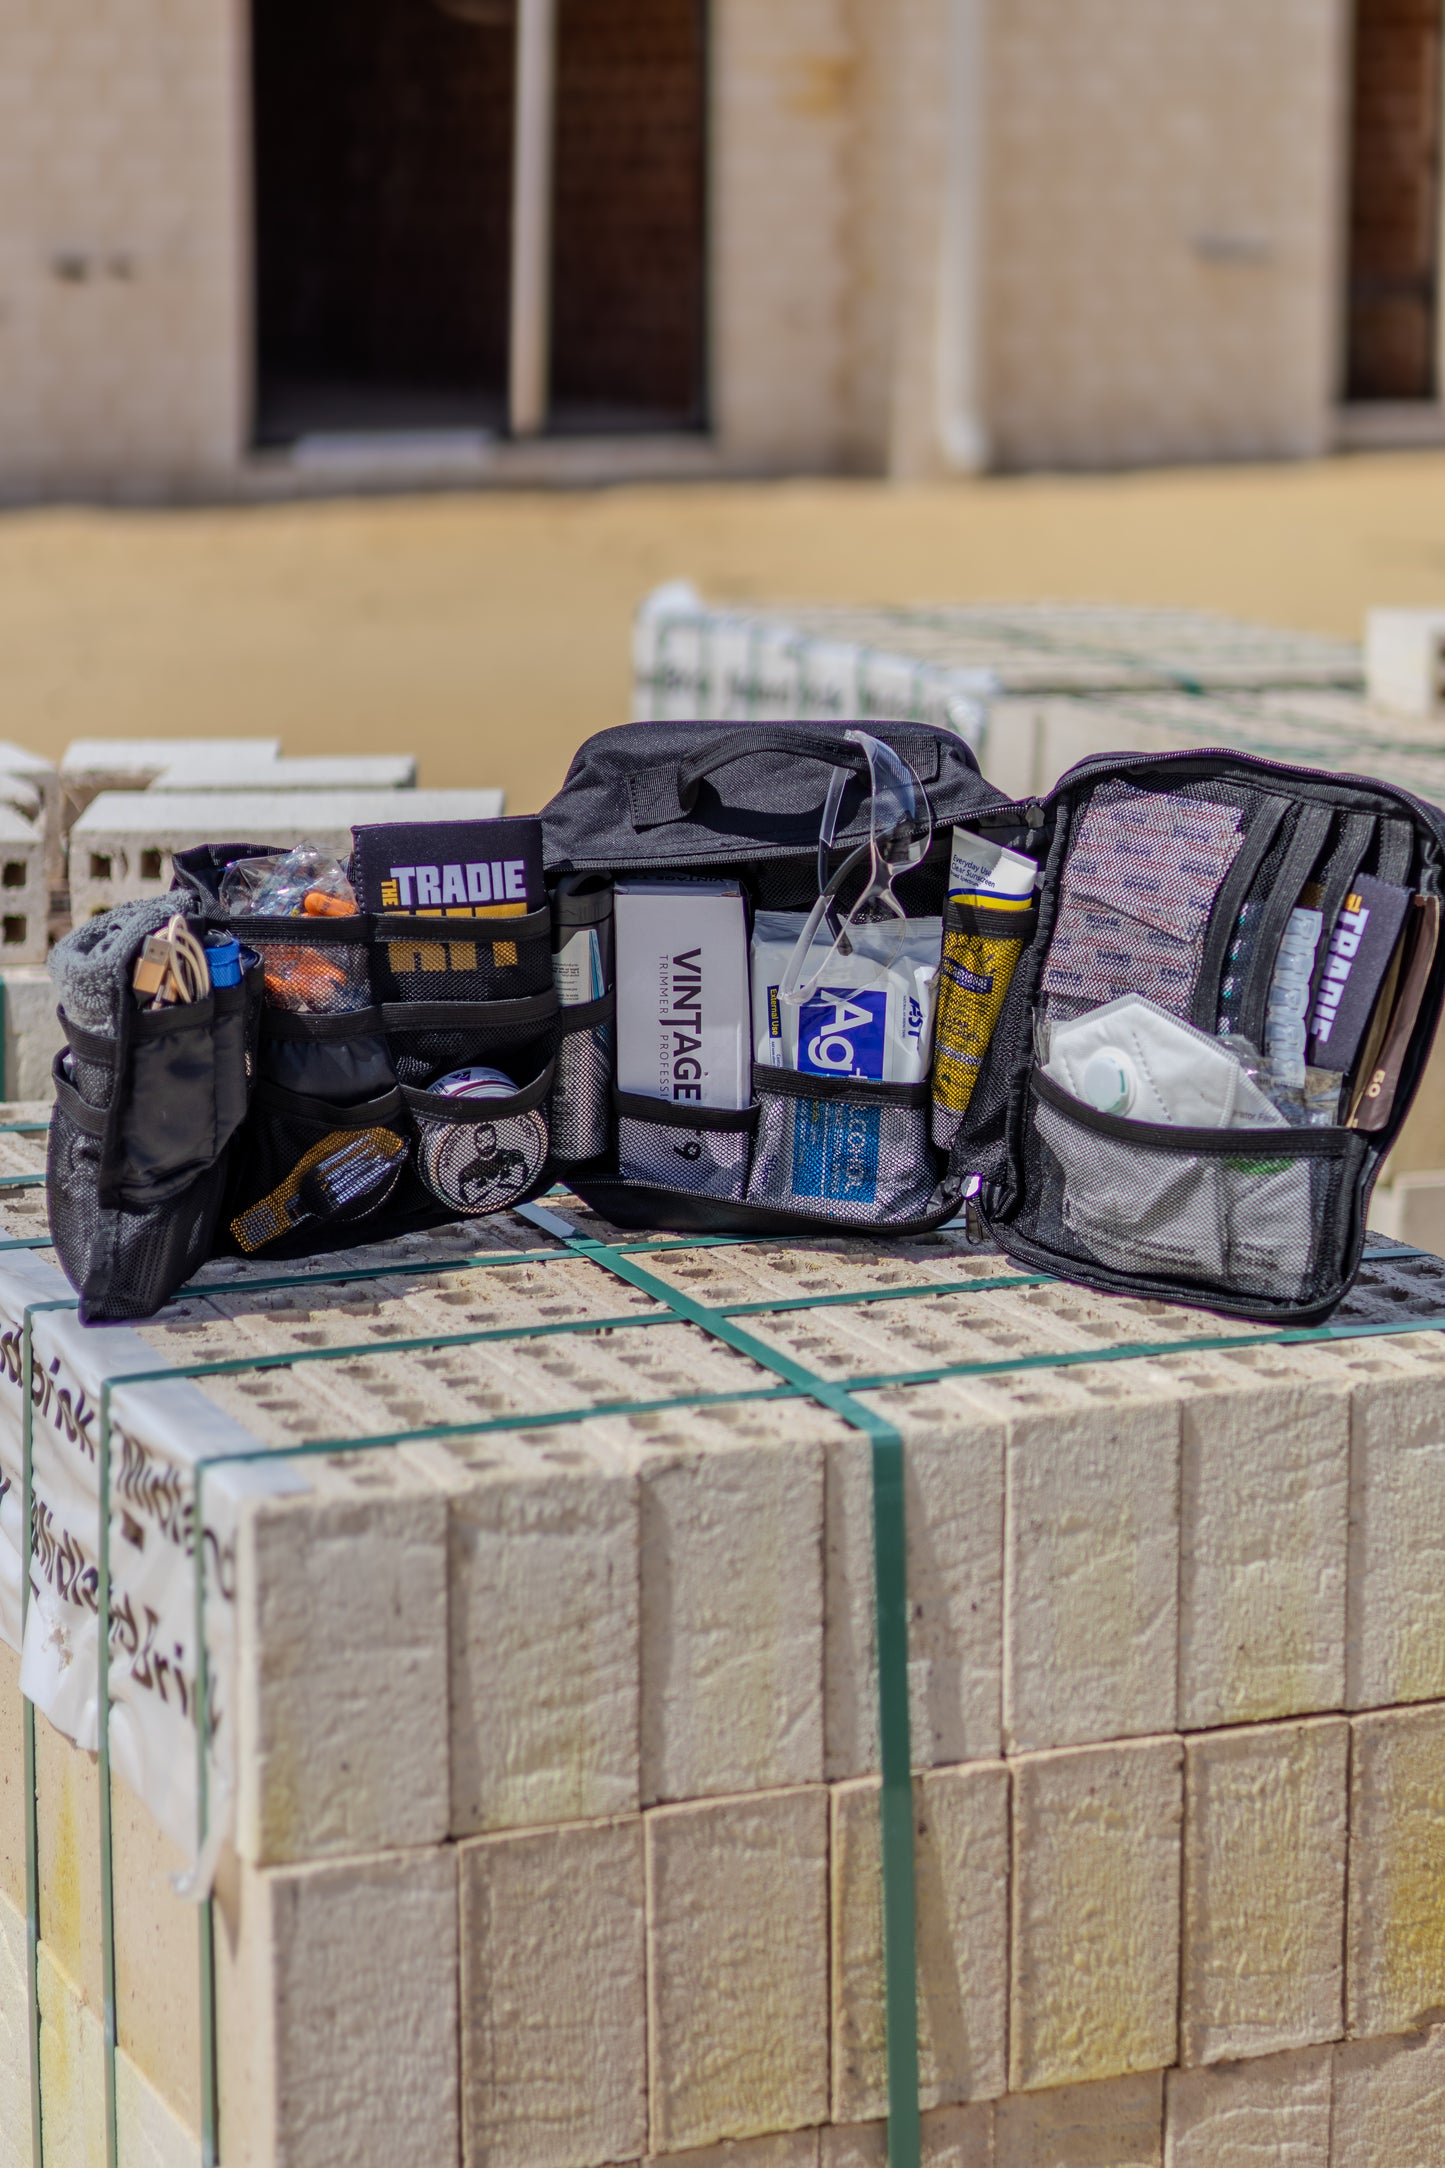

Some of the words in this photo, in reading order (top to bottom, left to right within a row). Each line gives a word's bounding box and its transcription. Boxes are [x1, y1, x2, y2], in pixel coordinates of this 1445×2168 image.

[390, 860, 527, 906] TRADIE
[952, 854, 979, 872] Everyday
[981, 866, 992, 877] Use
[952, 863, 966, 874] Clear
[966, 869, 996, 888] Sunscreen
[381, 879, 399, 907] THE
[659, 955, 669, 1014] TRIMMER
[770, 988, 779, 1020] External
[659, 948, 702, 1101] VINTAGE
[659, 1034, 669, 1098] PROFESSI
